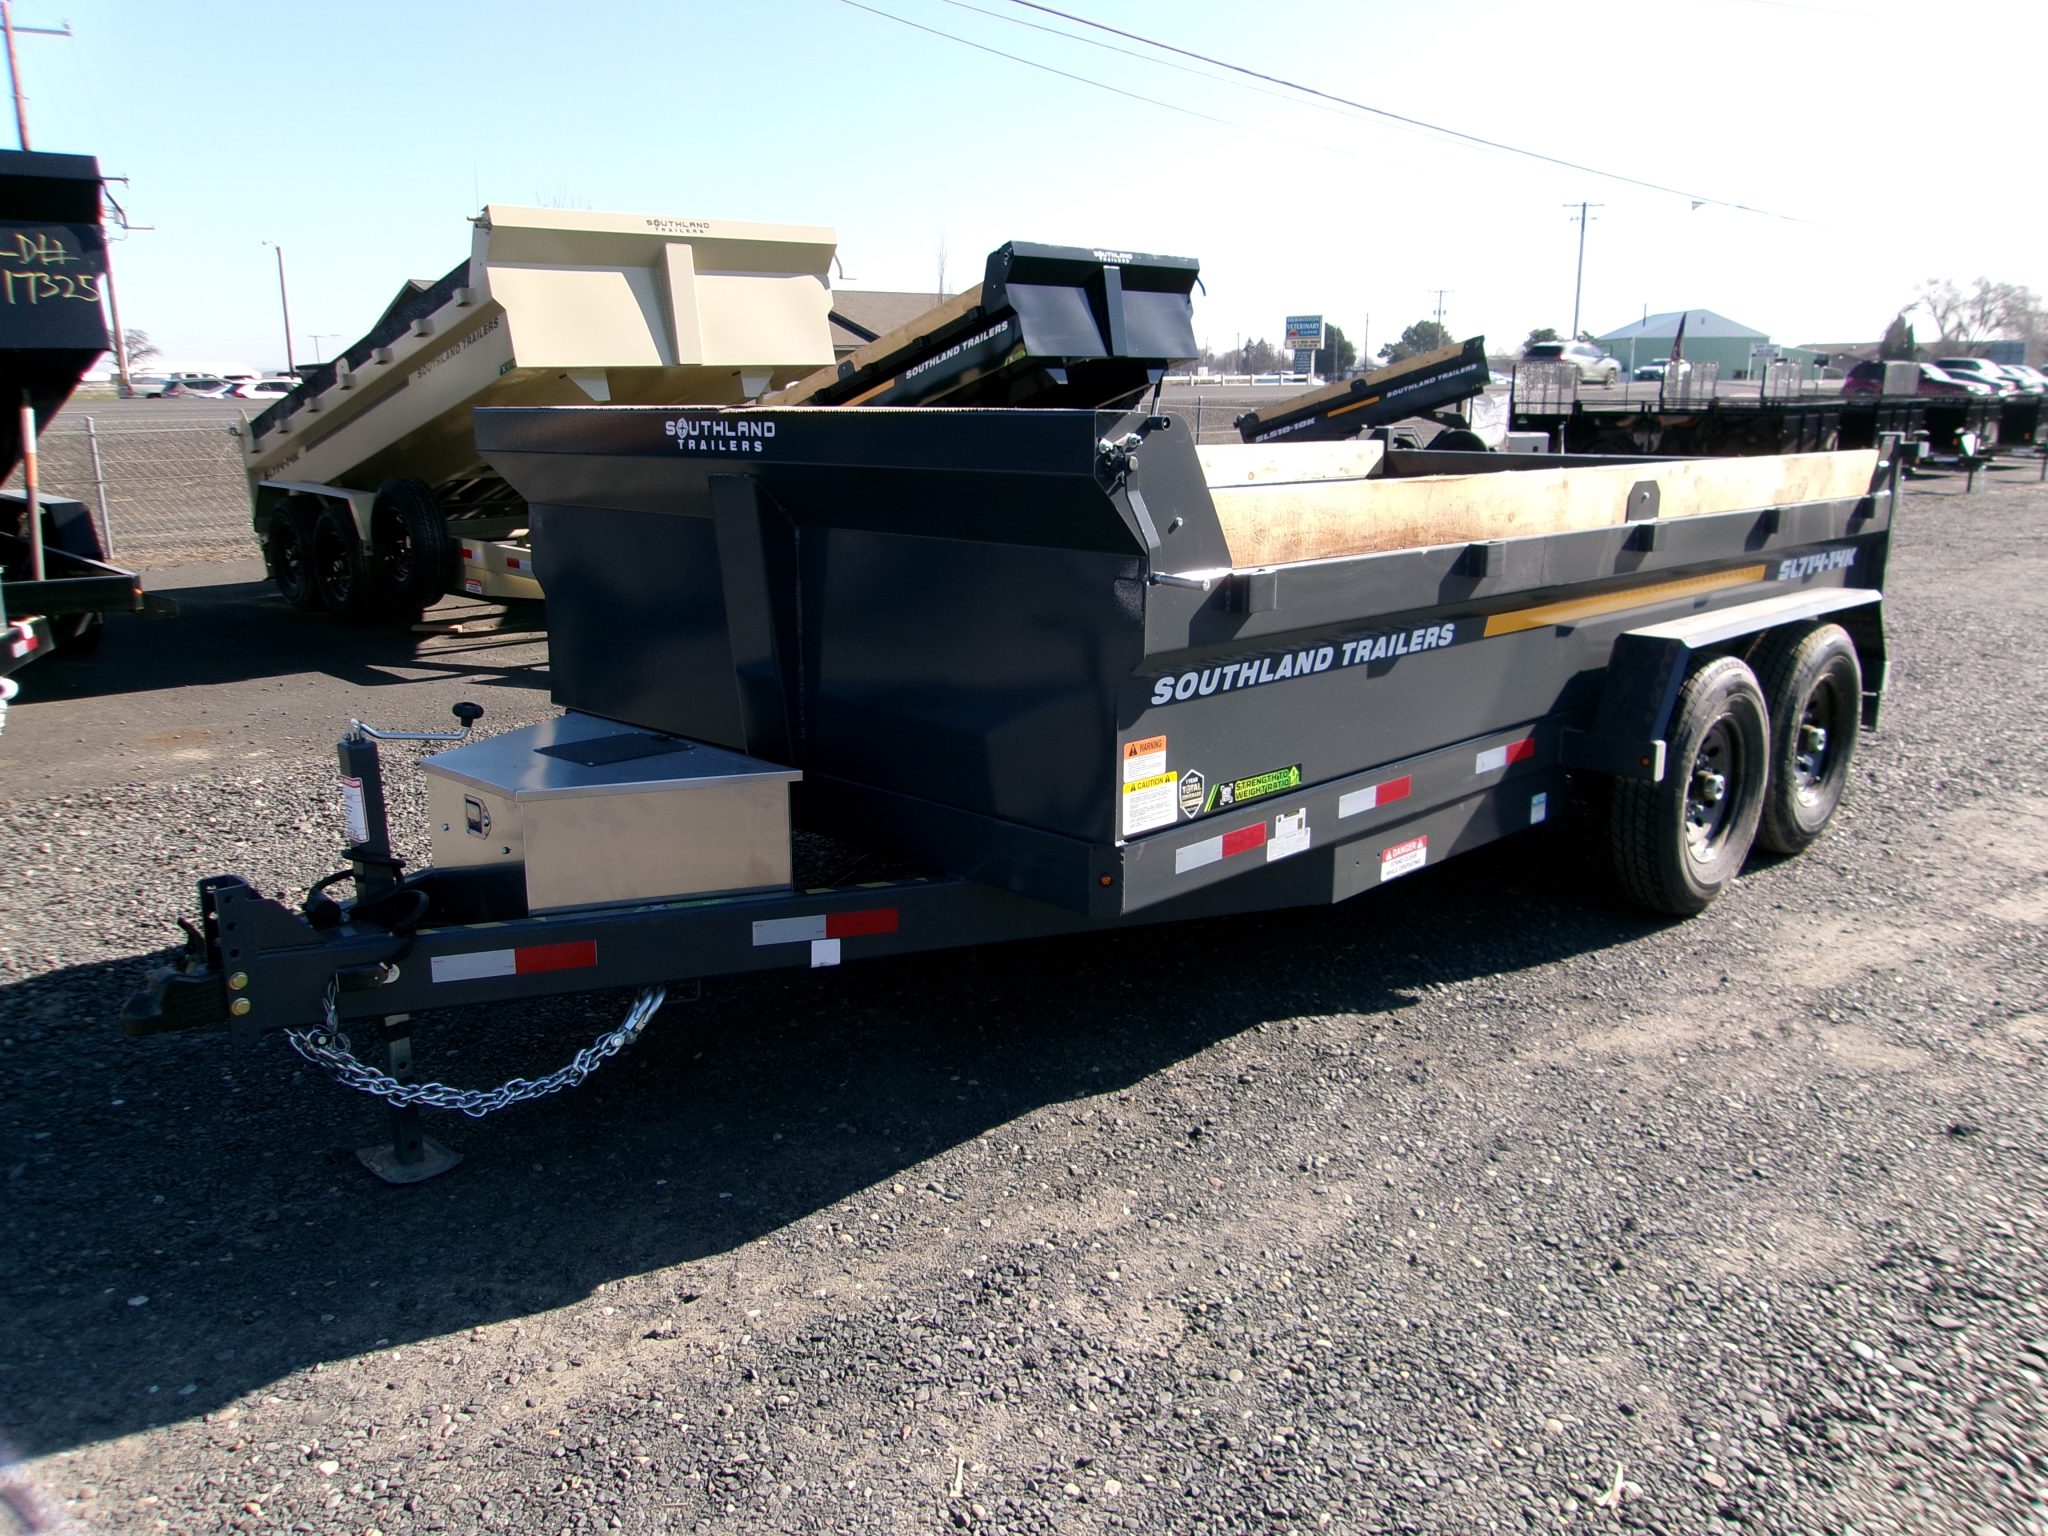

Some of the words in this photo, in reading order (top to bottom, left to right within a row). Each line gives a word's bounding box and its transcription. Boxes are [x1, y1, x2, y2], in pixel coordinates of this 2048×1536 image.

[646, 219, 710, 229] SOUTHLAND
[417, 344, 461, 379] SOUTHLAND
[463, 317, 499, 350] TRAILERS
[906, 345, 960, 379] SOUTHLAND
[962, 320, 1008, 351] TRAILERS
[1386, 377, 1436, 398] SOUTHLAND
[1438, 363, 1477, 381] TRAILERS
[665, 417, 776, 439] SOUTHLAND
[677, 439, 763, 453] TRAILERS
[1777, 547, 1858, 581] SL714-14K
[1151, 646, 1334, 706] SOUTHLAND
[1342, 623, 1455, 667] TRAILERS
[1139, 739, 1162, 752] WARNING
[1137, 777, 1164, 790] CAUTION
[1182, 783, 1201, 794] TOTAL
[1236, 785, 1267, 799] WEIGHT
[1267, 779, 1289, 793] RATIO
[1393, 841, 1417, 858] DANGER
